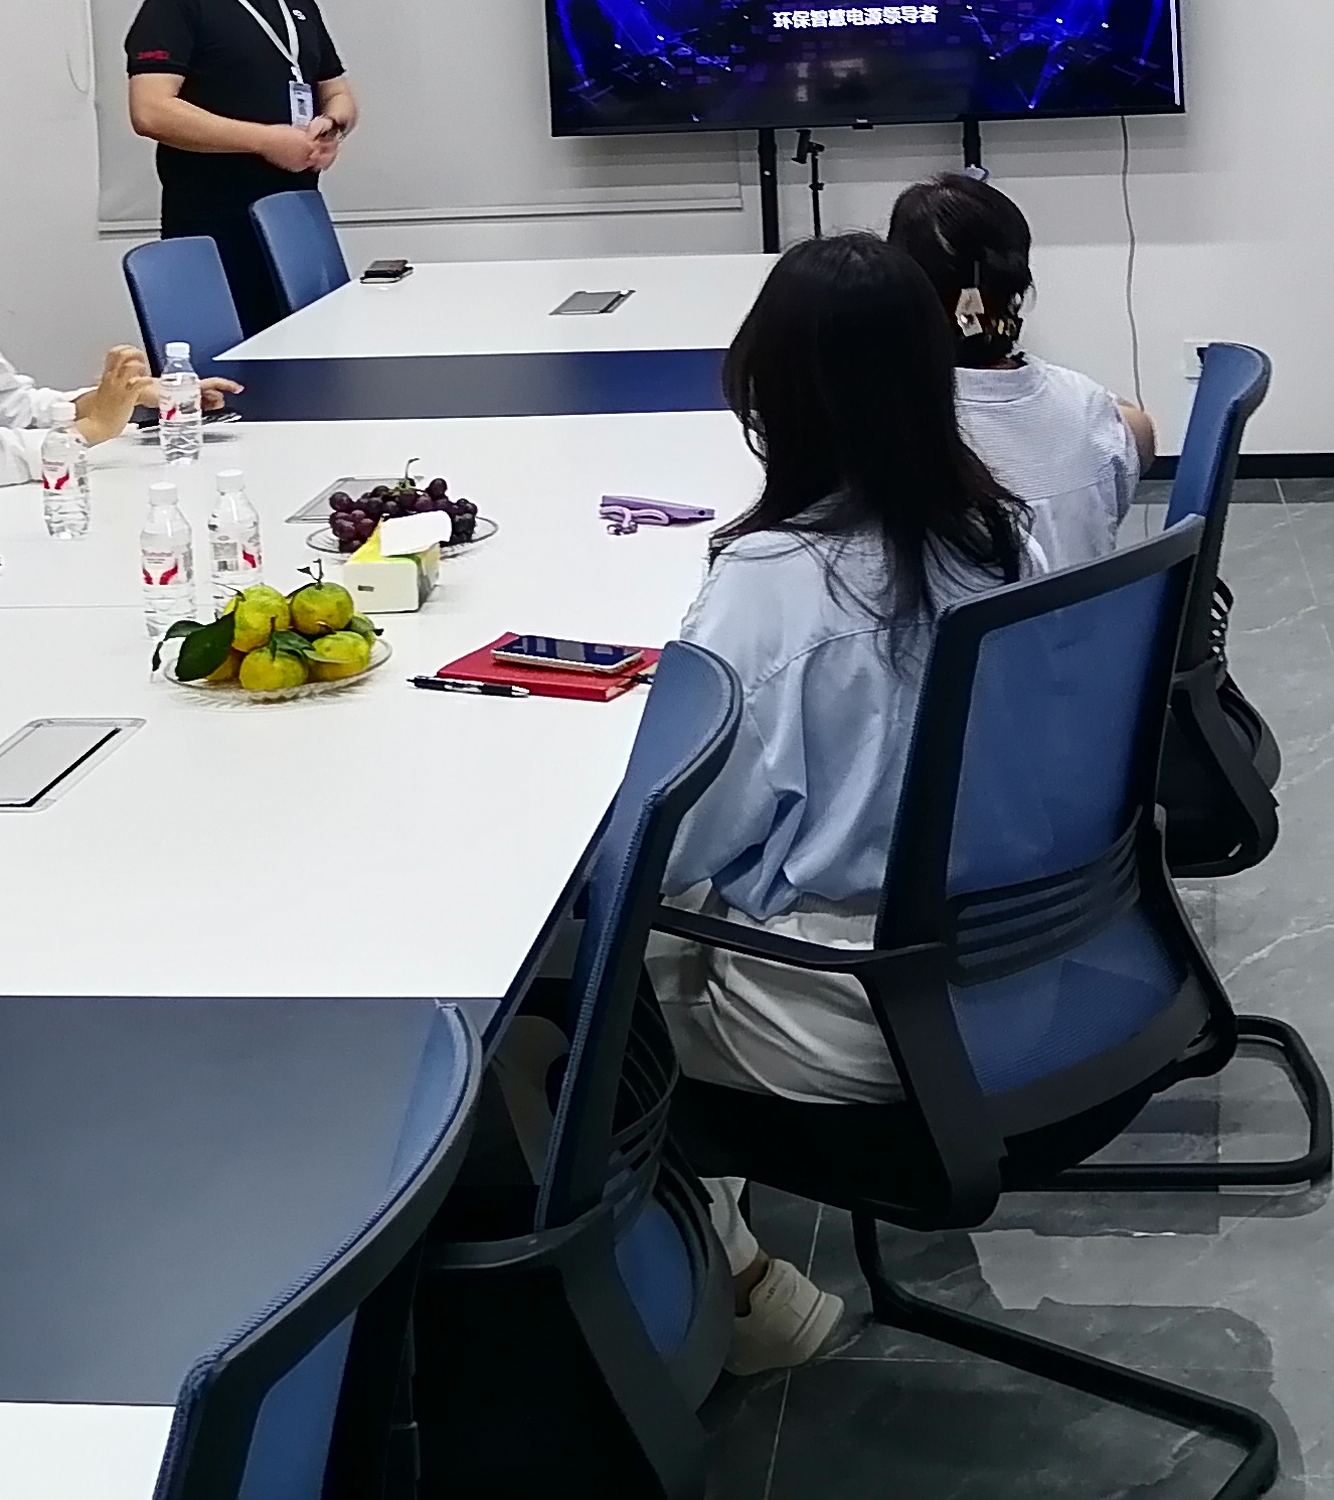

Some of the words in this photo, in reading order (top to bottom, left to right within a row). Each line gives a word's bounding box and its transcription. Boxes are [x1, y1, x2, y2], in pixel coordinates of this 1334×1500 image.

[772, 4, 939, 30] 环保智慧电源领导者
